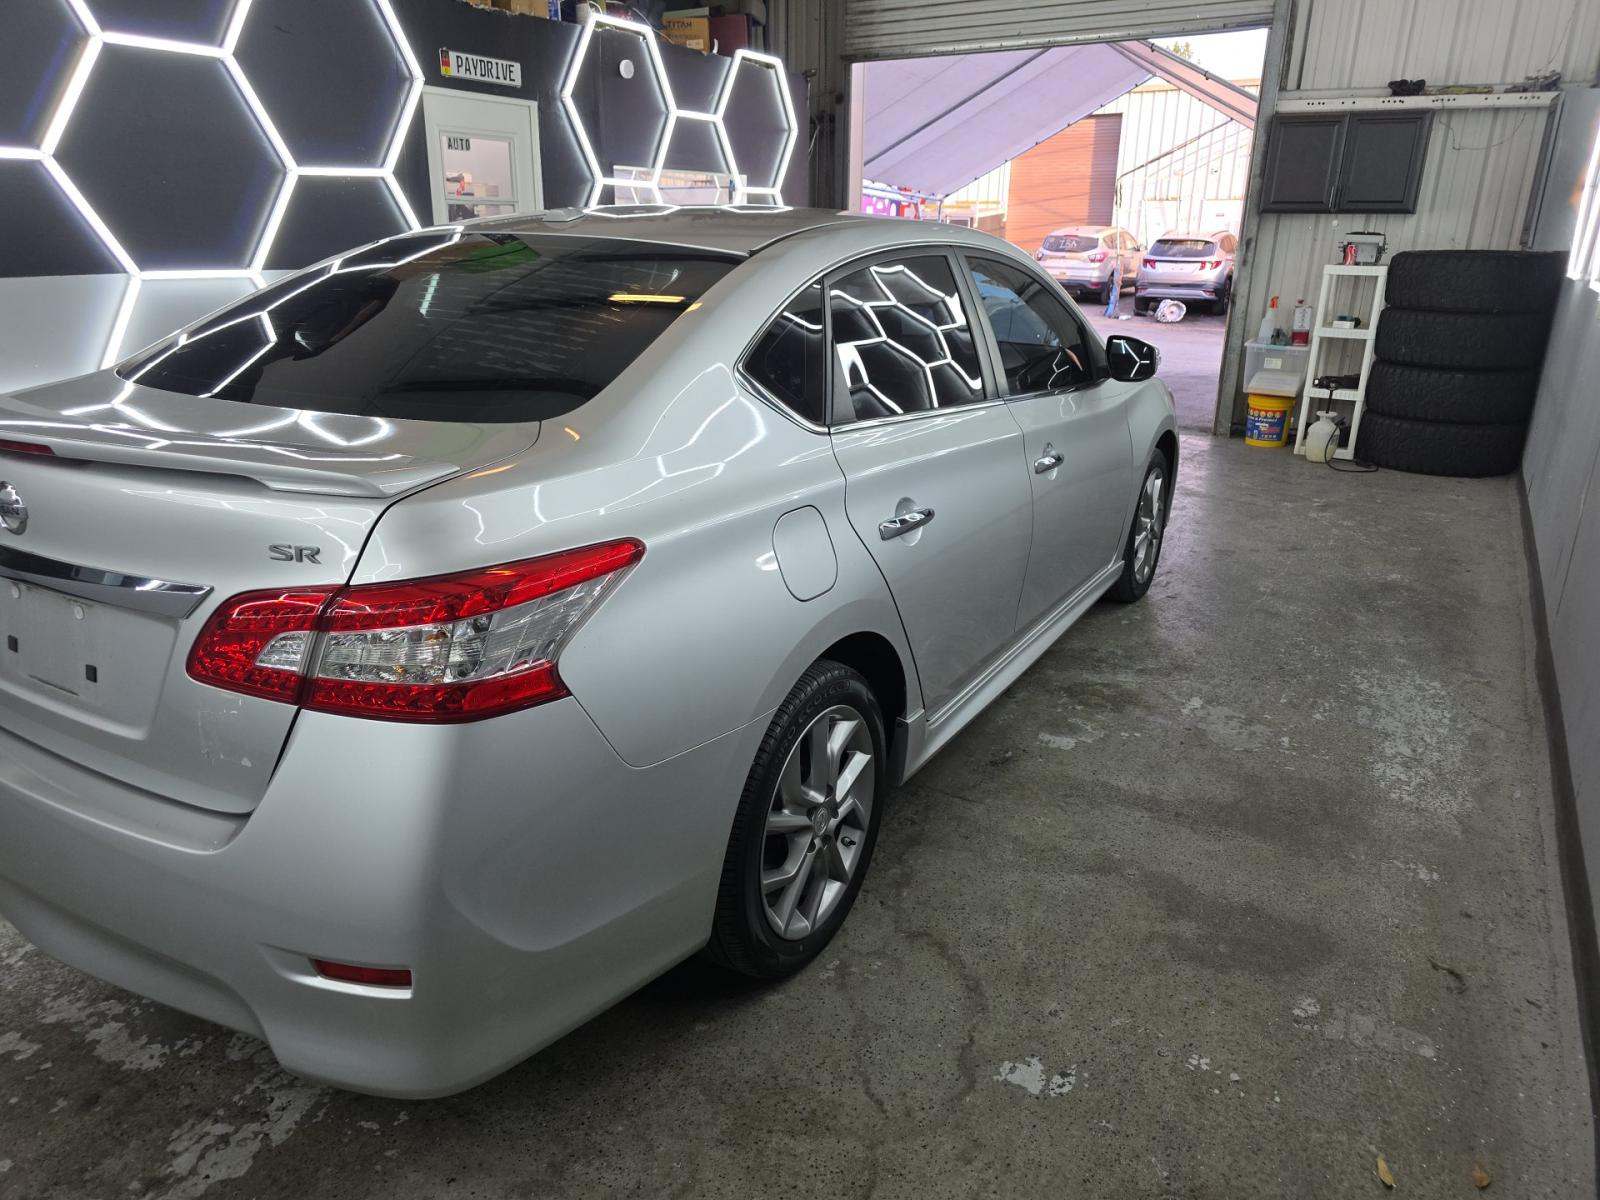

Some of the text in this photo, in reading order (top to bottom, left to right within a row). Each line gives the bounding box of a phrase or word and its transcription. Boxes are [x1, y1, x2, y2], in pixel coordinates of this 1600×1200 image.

[456, 55, 516, 82] PAYDRIVE
[447, 137, 471, 151] AUTO
[269, 544, 321, 564] SR
